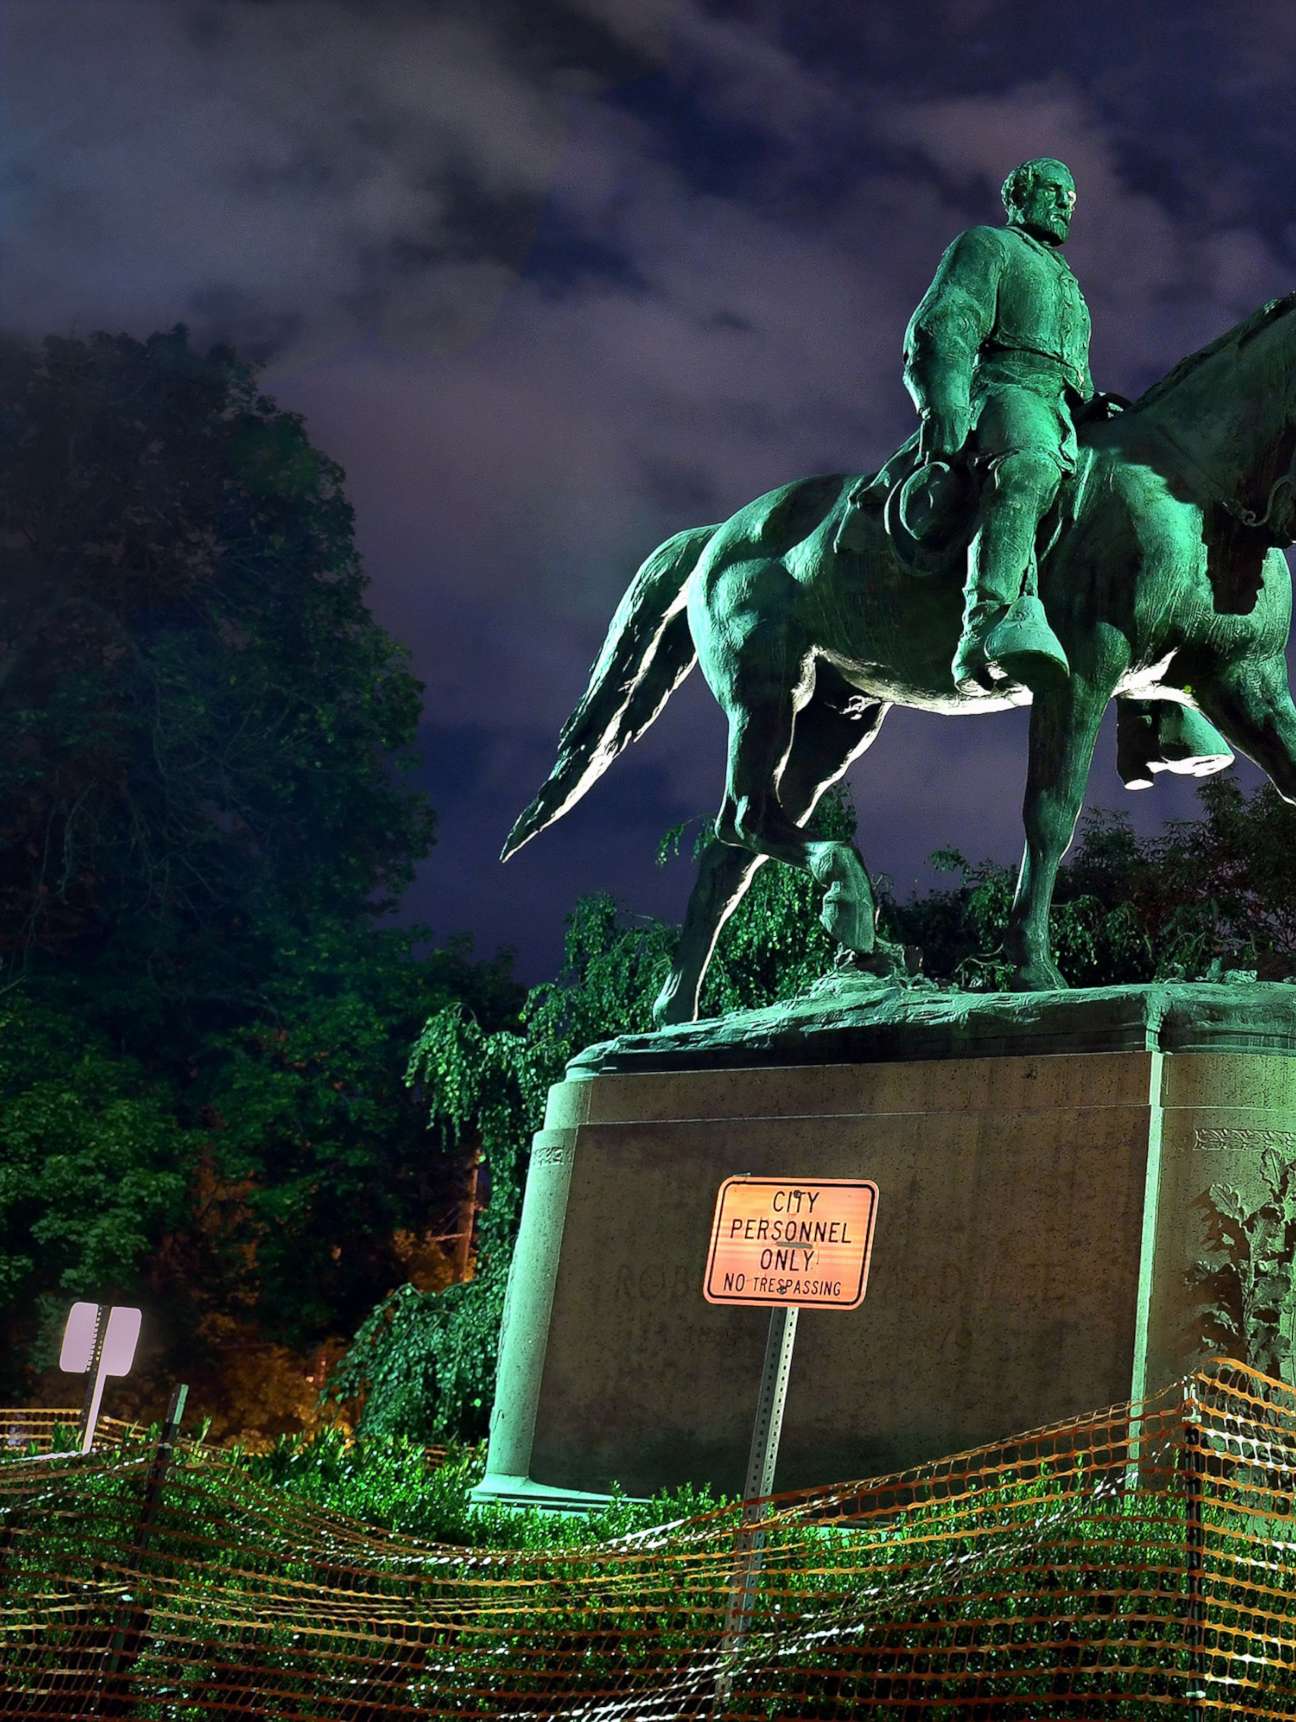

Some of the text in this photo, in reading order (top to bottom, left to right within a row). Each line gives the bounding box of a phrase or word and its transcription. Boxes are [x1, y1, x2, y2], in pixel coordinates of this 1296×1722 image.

[772, 1190, 820, 1214] CITY
[729, 1218, 852, 1244] PERSONNEL
[760, 1248, 815, 1272] ONLY
[723, 1273, 746, 1292] NO
[753, 1276, 842, 1297] TRESPASSING
